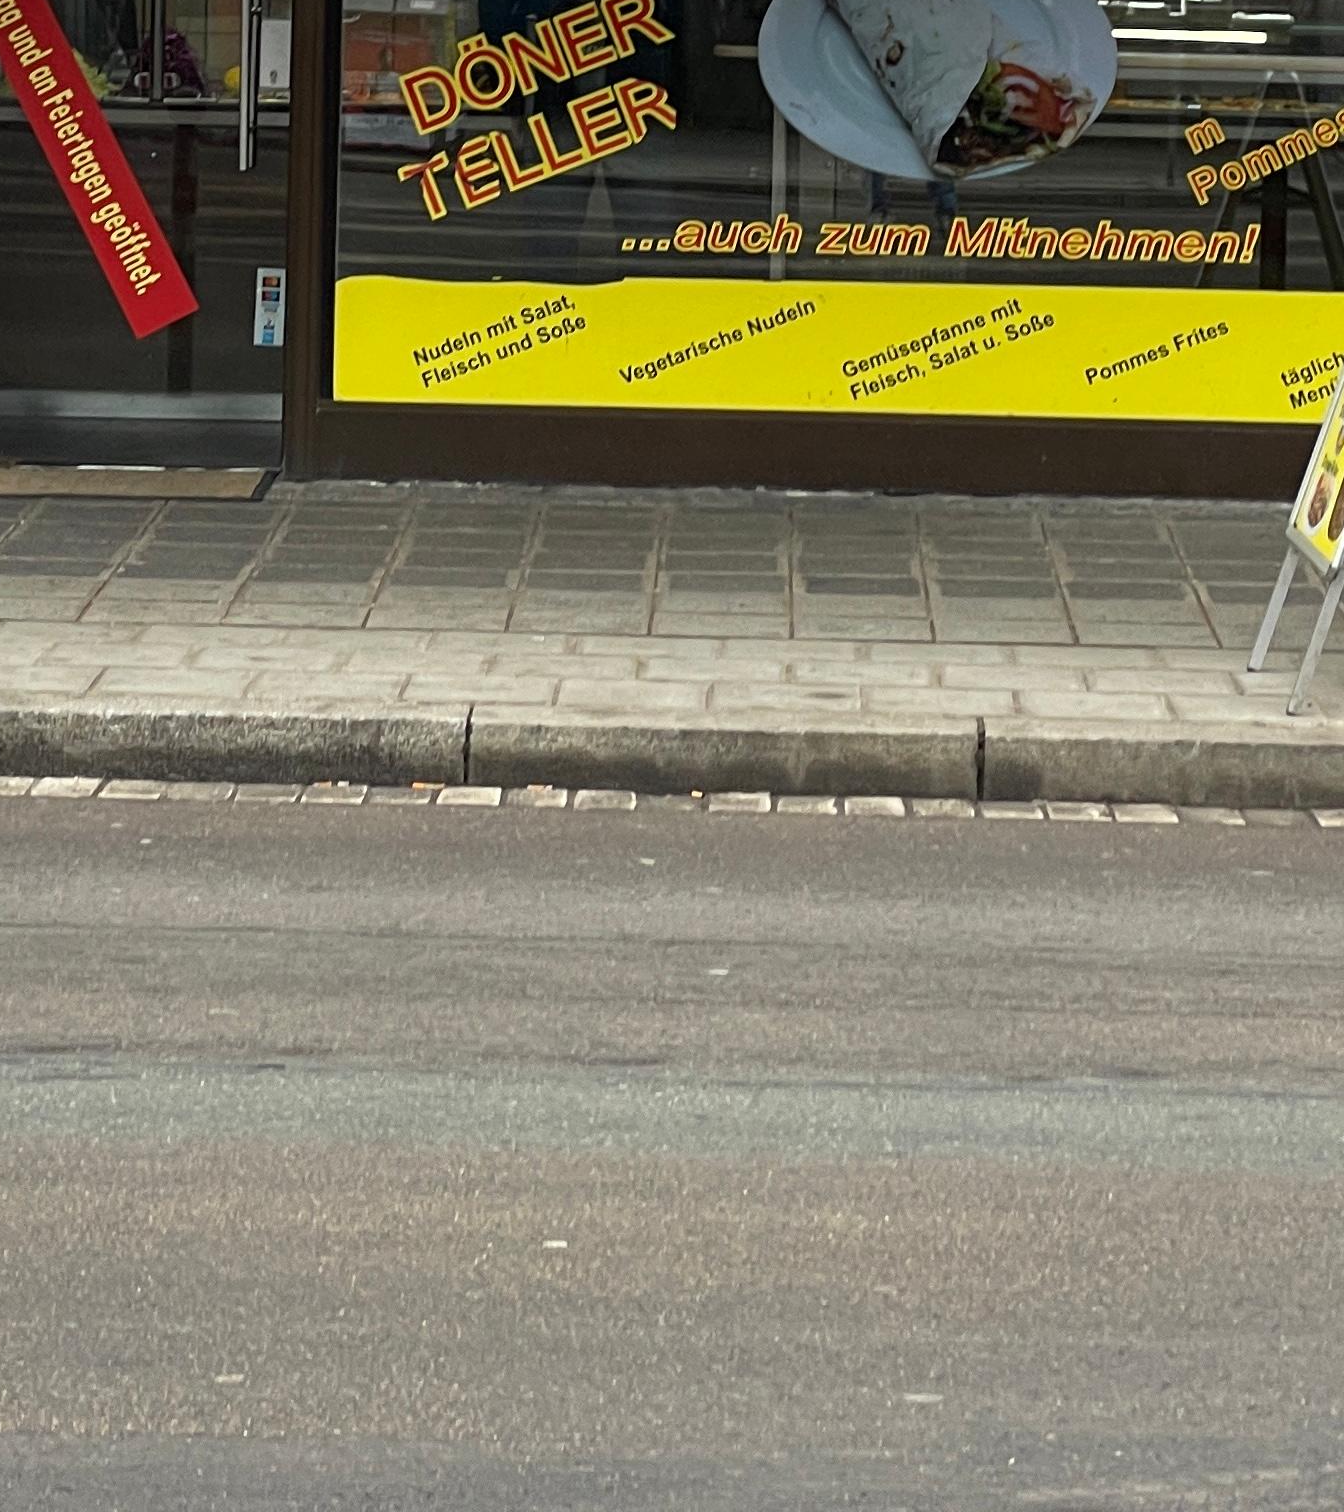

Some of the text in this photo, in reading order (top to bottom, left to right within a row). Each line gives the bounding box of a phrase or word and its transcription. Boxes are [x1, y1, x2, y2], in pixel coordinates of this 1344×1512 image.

[8, 24, 53, 68] und
[29, 64, 58, 97] an
[42, 88, 113, 205] Feiertagen
[398, 77, 677, 221] TELLER
[89, 200, 162, 296] geöffnet.
[815, 222, 930, 256] zum
[944, 216, 1262, 265] Mitnehmen!
[411, 293, 577, 368] Nudeln mit Salat,
[420, 314, 588, 389] Fleisch und Soße
[619, 299, 818, 385] Vegetarische Nudeln
[841, 298, 1024, 379] Gemüsepfanne mit
[848, 311, 1056, 401] Fleisch, Salat u. Soße
[1085, 319, 1231, 386] Pommes Frites
